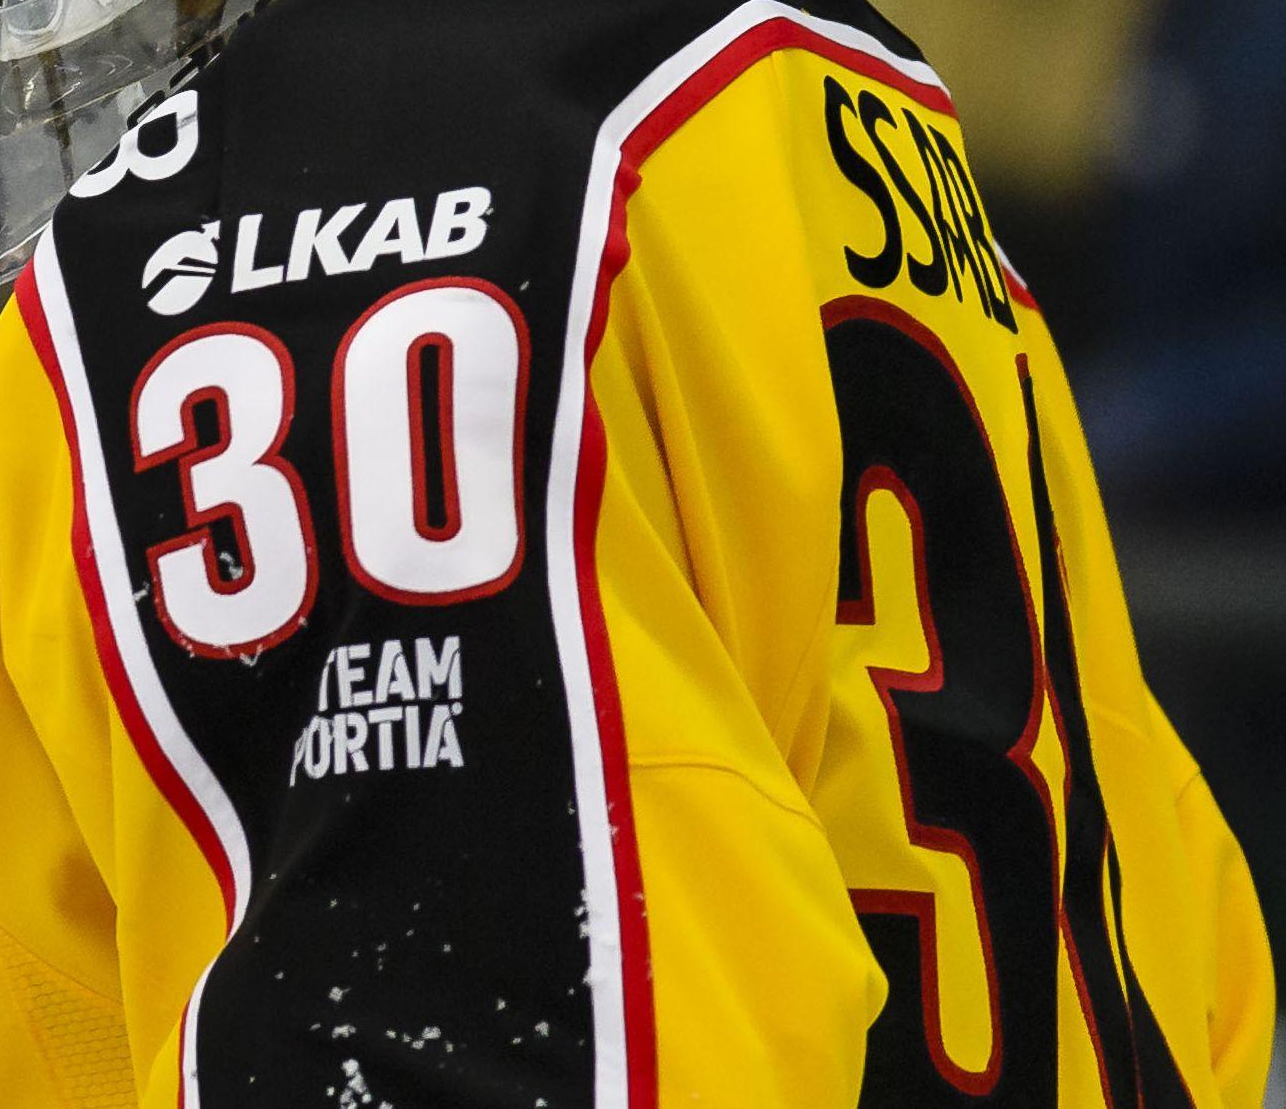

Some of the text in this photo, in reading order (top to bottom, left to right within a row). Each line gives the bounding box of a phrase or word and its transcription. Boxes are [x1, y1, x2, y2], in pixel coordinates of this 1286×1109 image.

[231, 186, 492, 293] LKAB
[823, 74, 1018, 335] SSAB
[129, 276, 531, 660] 30
